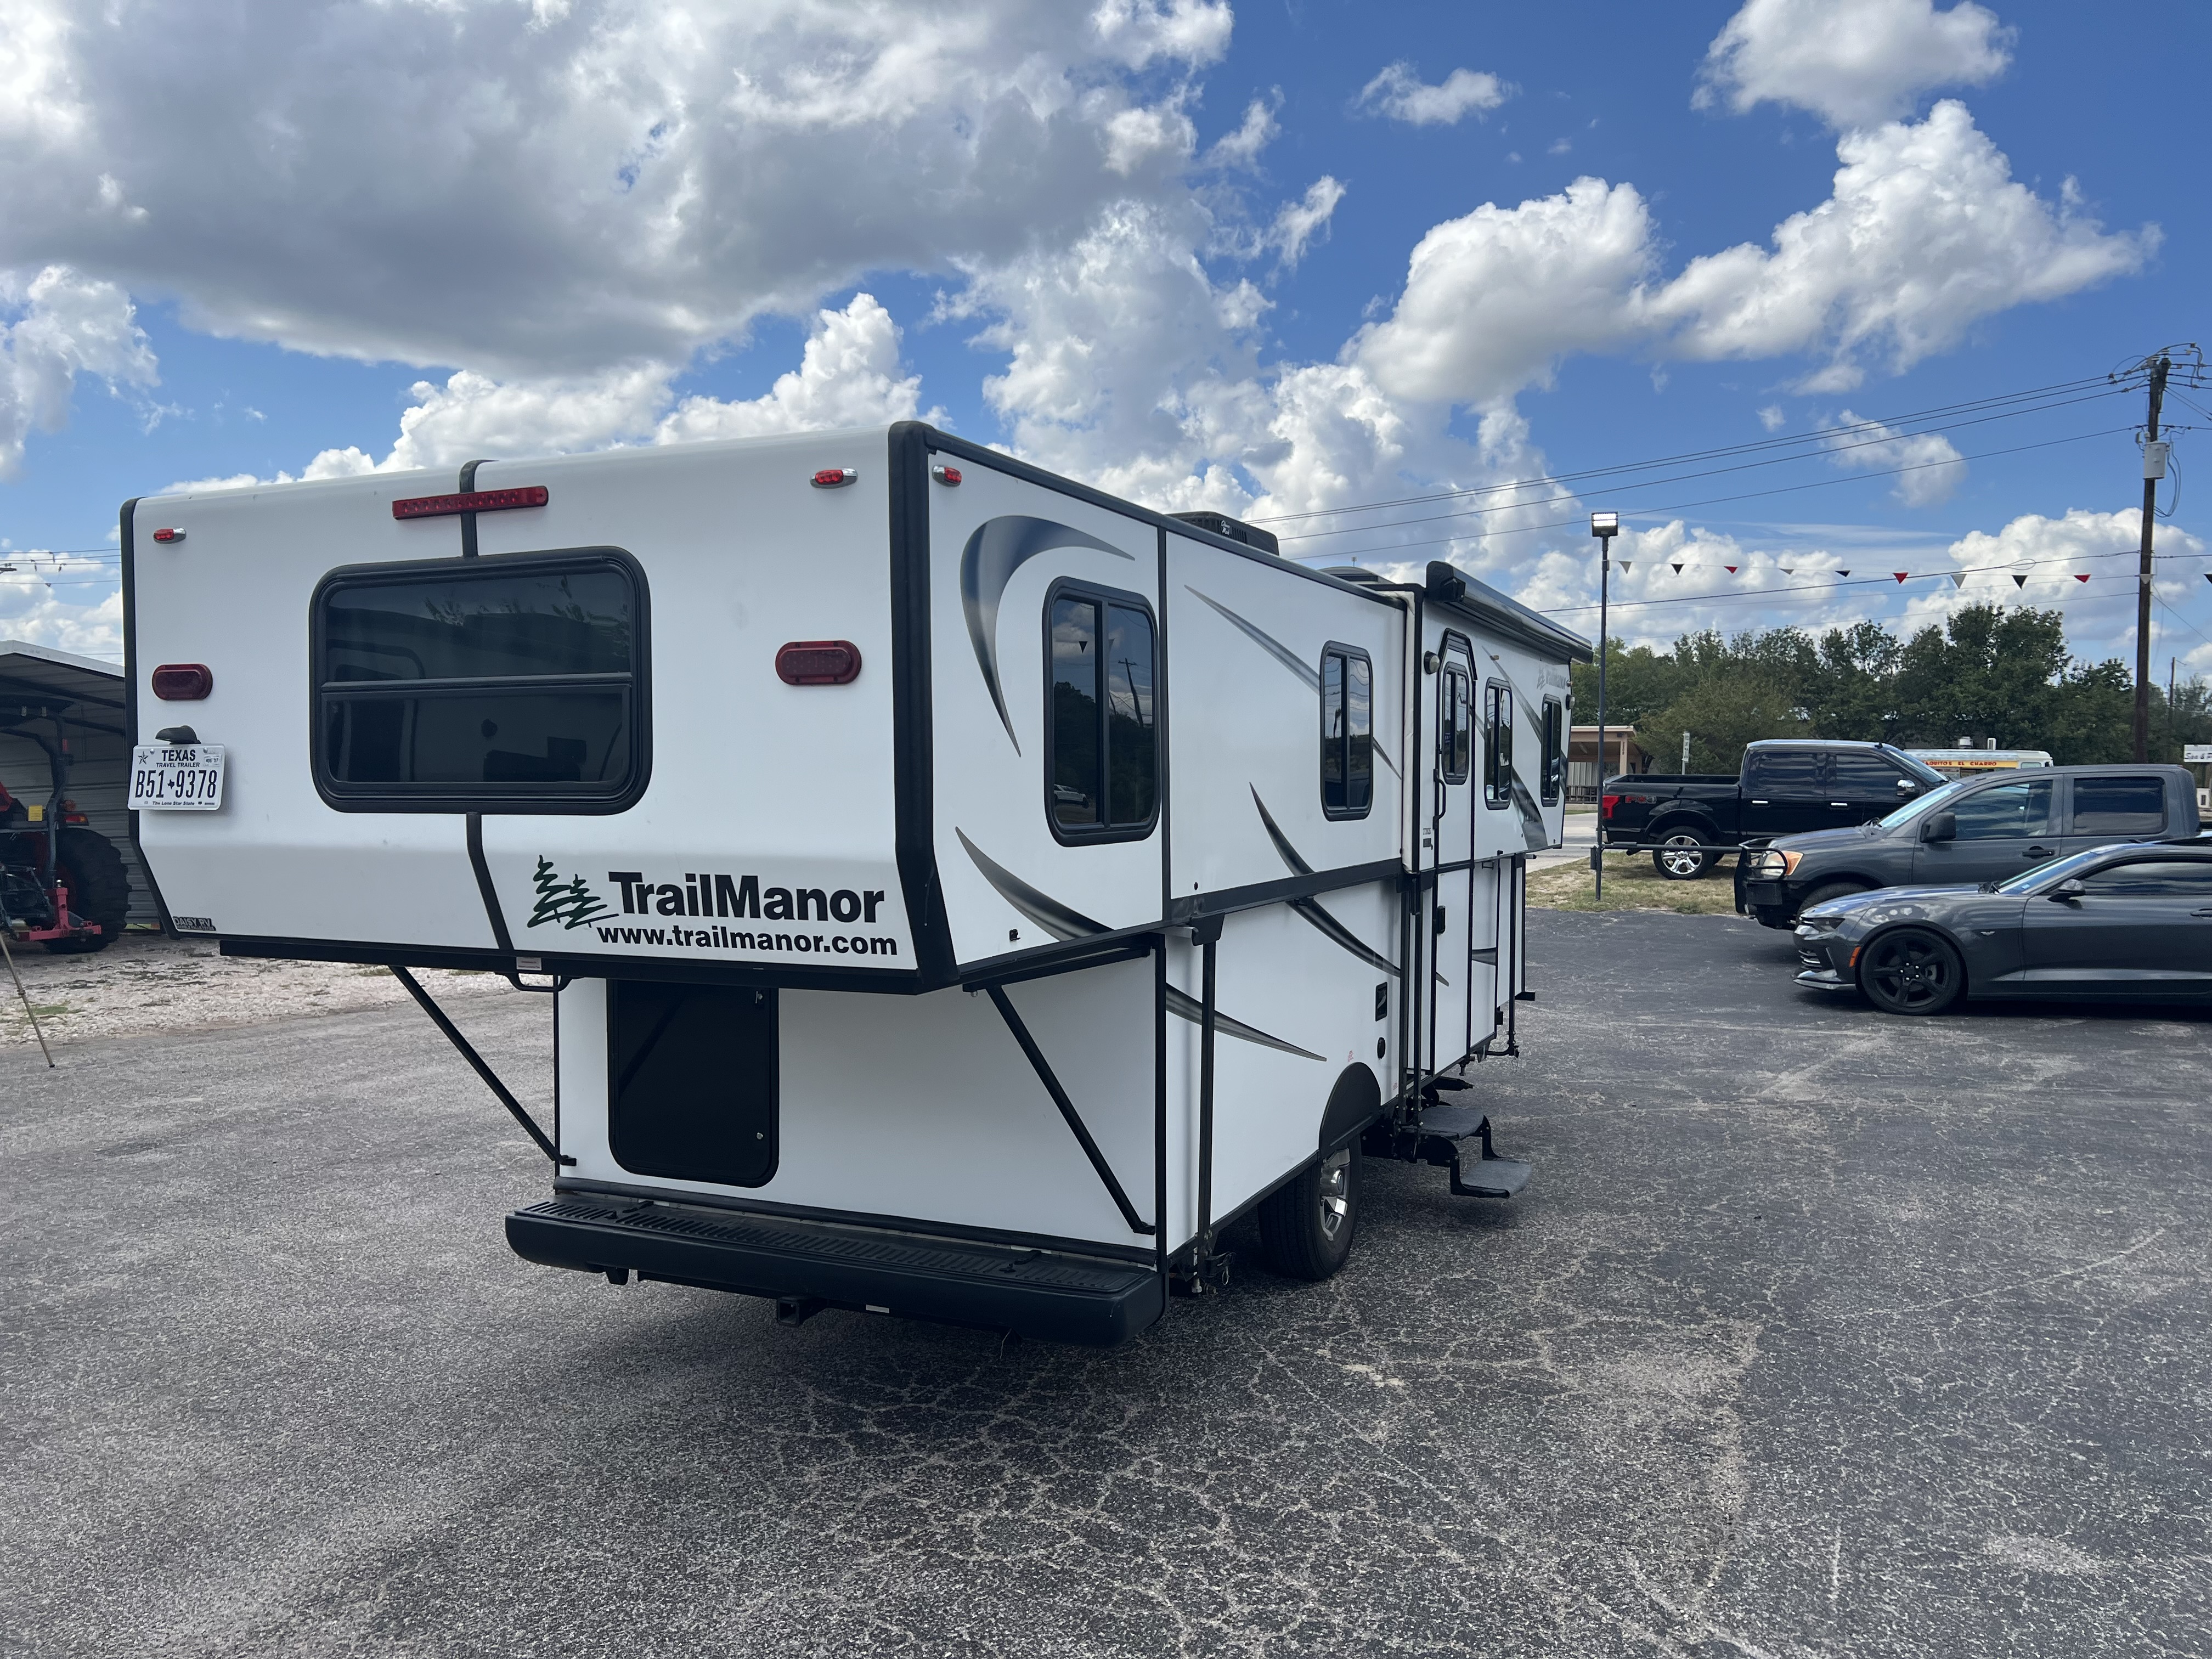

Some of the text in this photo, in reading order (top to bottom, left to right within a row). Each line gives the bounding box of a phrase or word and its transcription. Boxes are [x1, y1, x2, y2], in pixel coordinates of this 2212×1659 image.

[162, 749, 196, 761] TEXAS
[135, 770, 217, 798] B51 9378
[608, 871, 885, 923] TrailManor
[173, 916, 211, 927] DAISY RV
[597, 926, 898, 955] www.trailmanor.com
